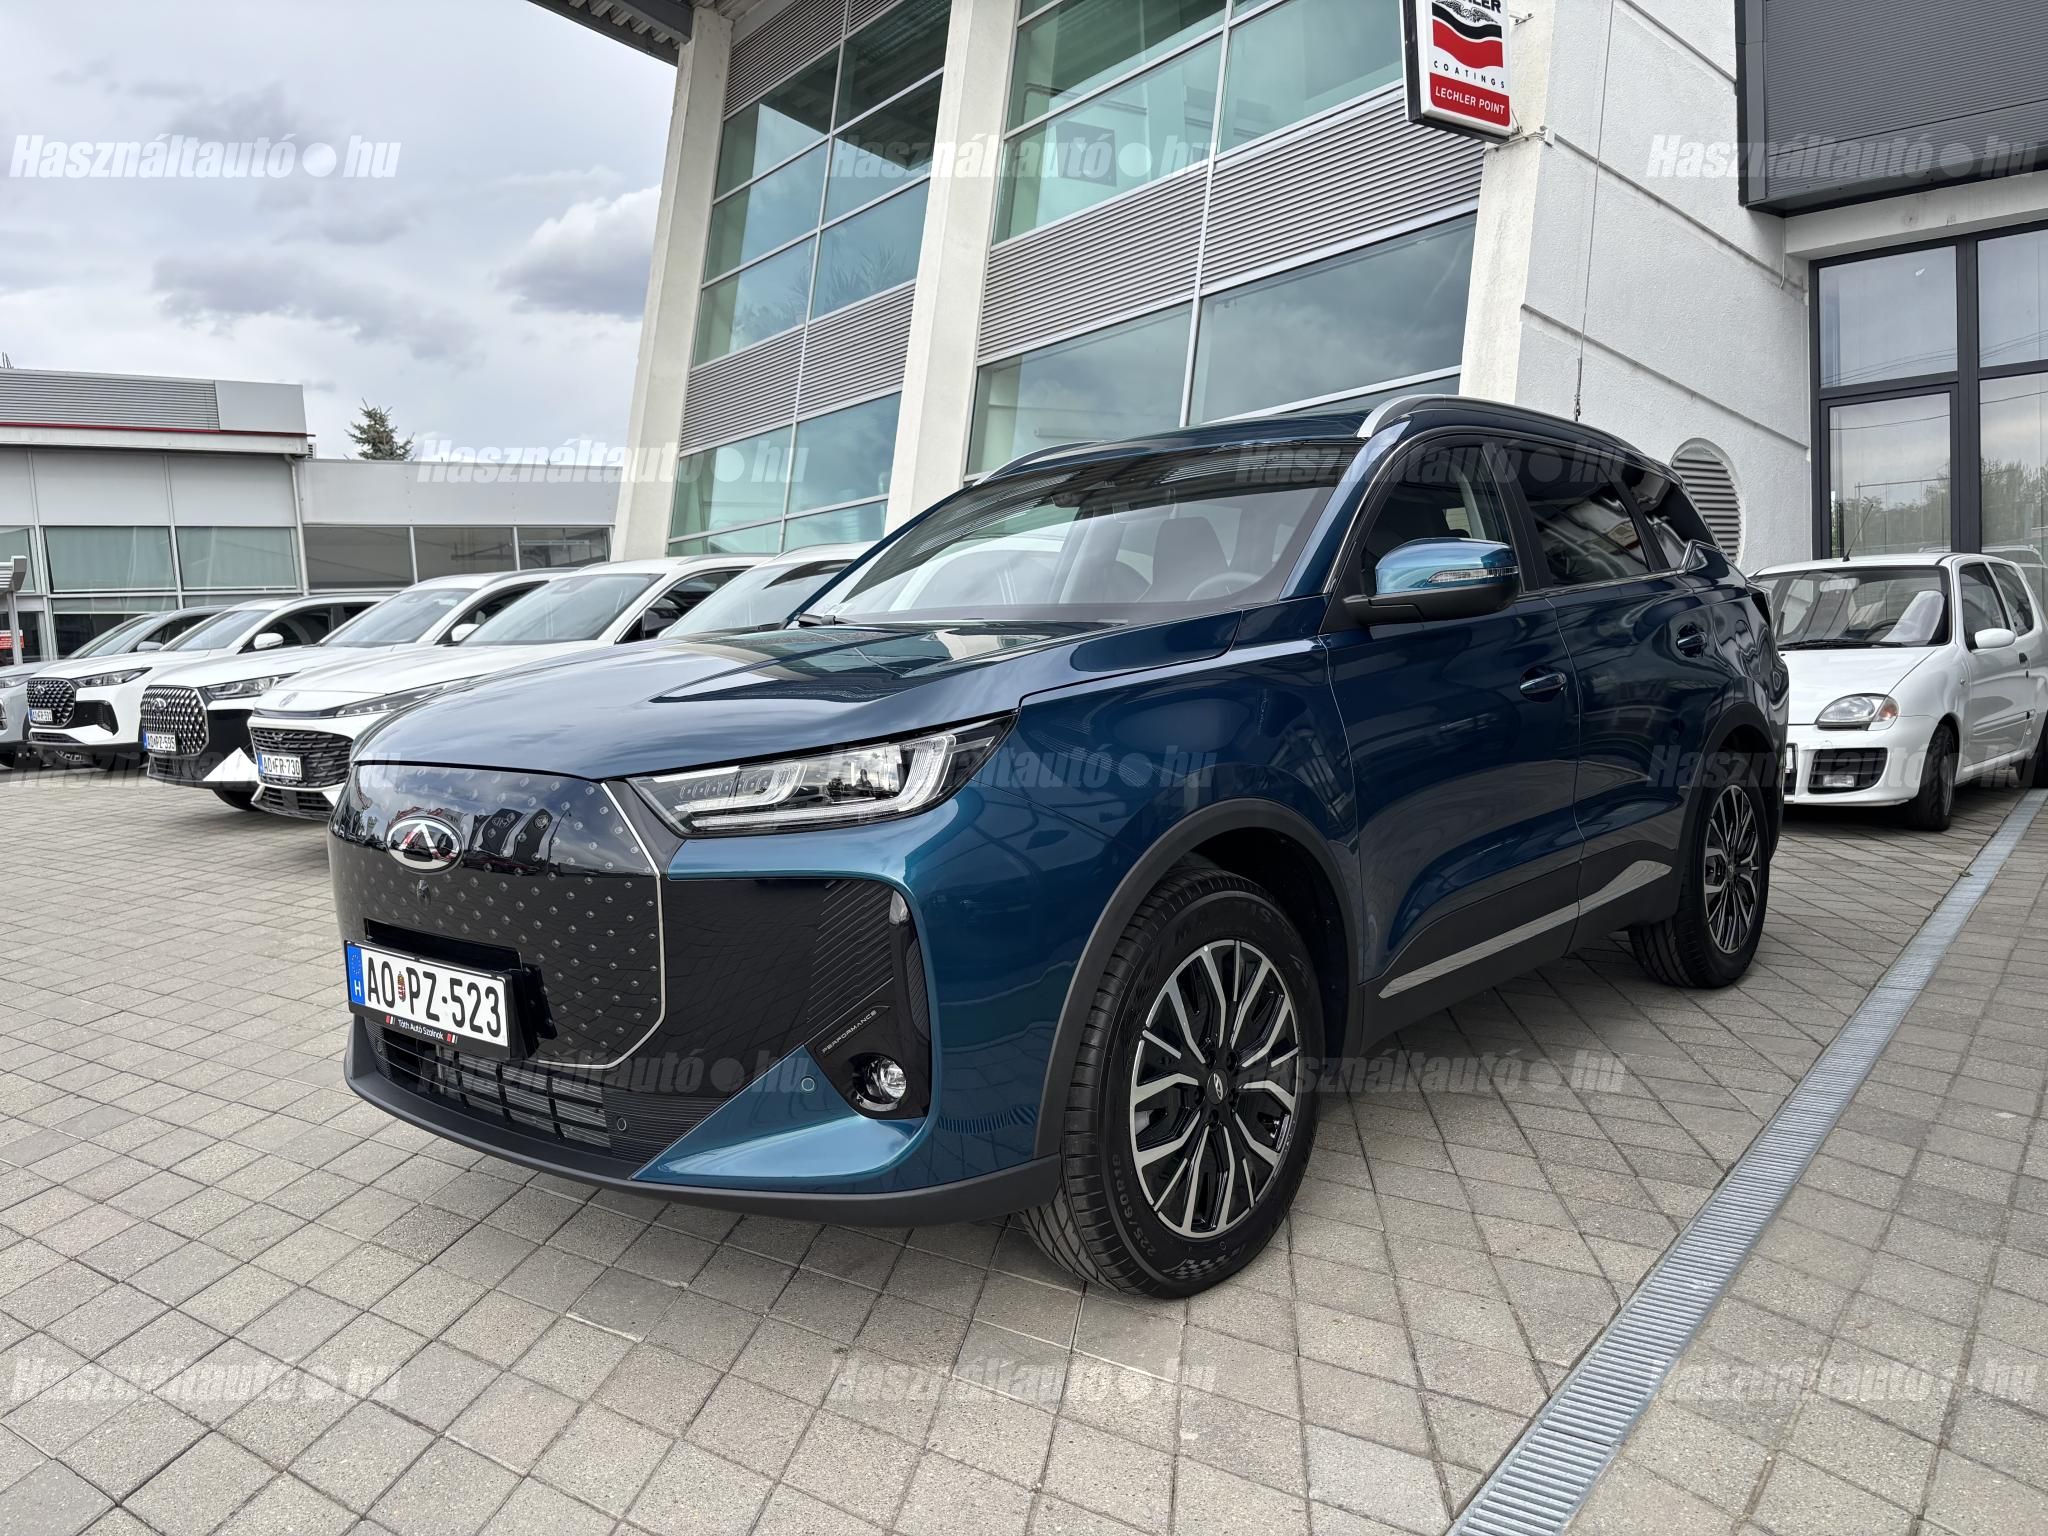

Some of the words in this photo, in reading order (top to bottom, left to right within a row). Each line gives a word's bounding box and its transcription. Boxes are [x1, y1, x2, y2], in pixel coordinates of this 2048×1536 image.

[1434, 60, 1505, 89] COATINGS
[1435, 86, 1477, 107] LECHLER
[1478, 98, 1505, 115] POINT
[273, 758, 301, 776] FR-730
[354, 980, 362, 997] H
[367, 957, 396, 1009] AO
[406, 966, 501, 1038] PZ-523
[398, 1018, 410, 1031] Tóth
[410, 1023, 423, 1034] Autó
[422, 1026, 444, 1040] Szolnok
[822, 1009, 877, 1054] PERFORMANCE
